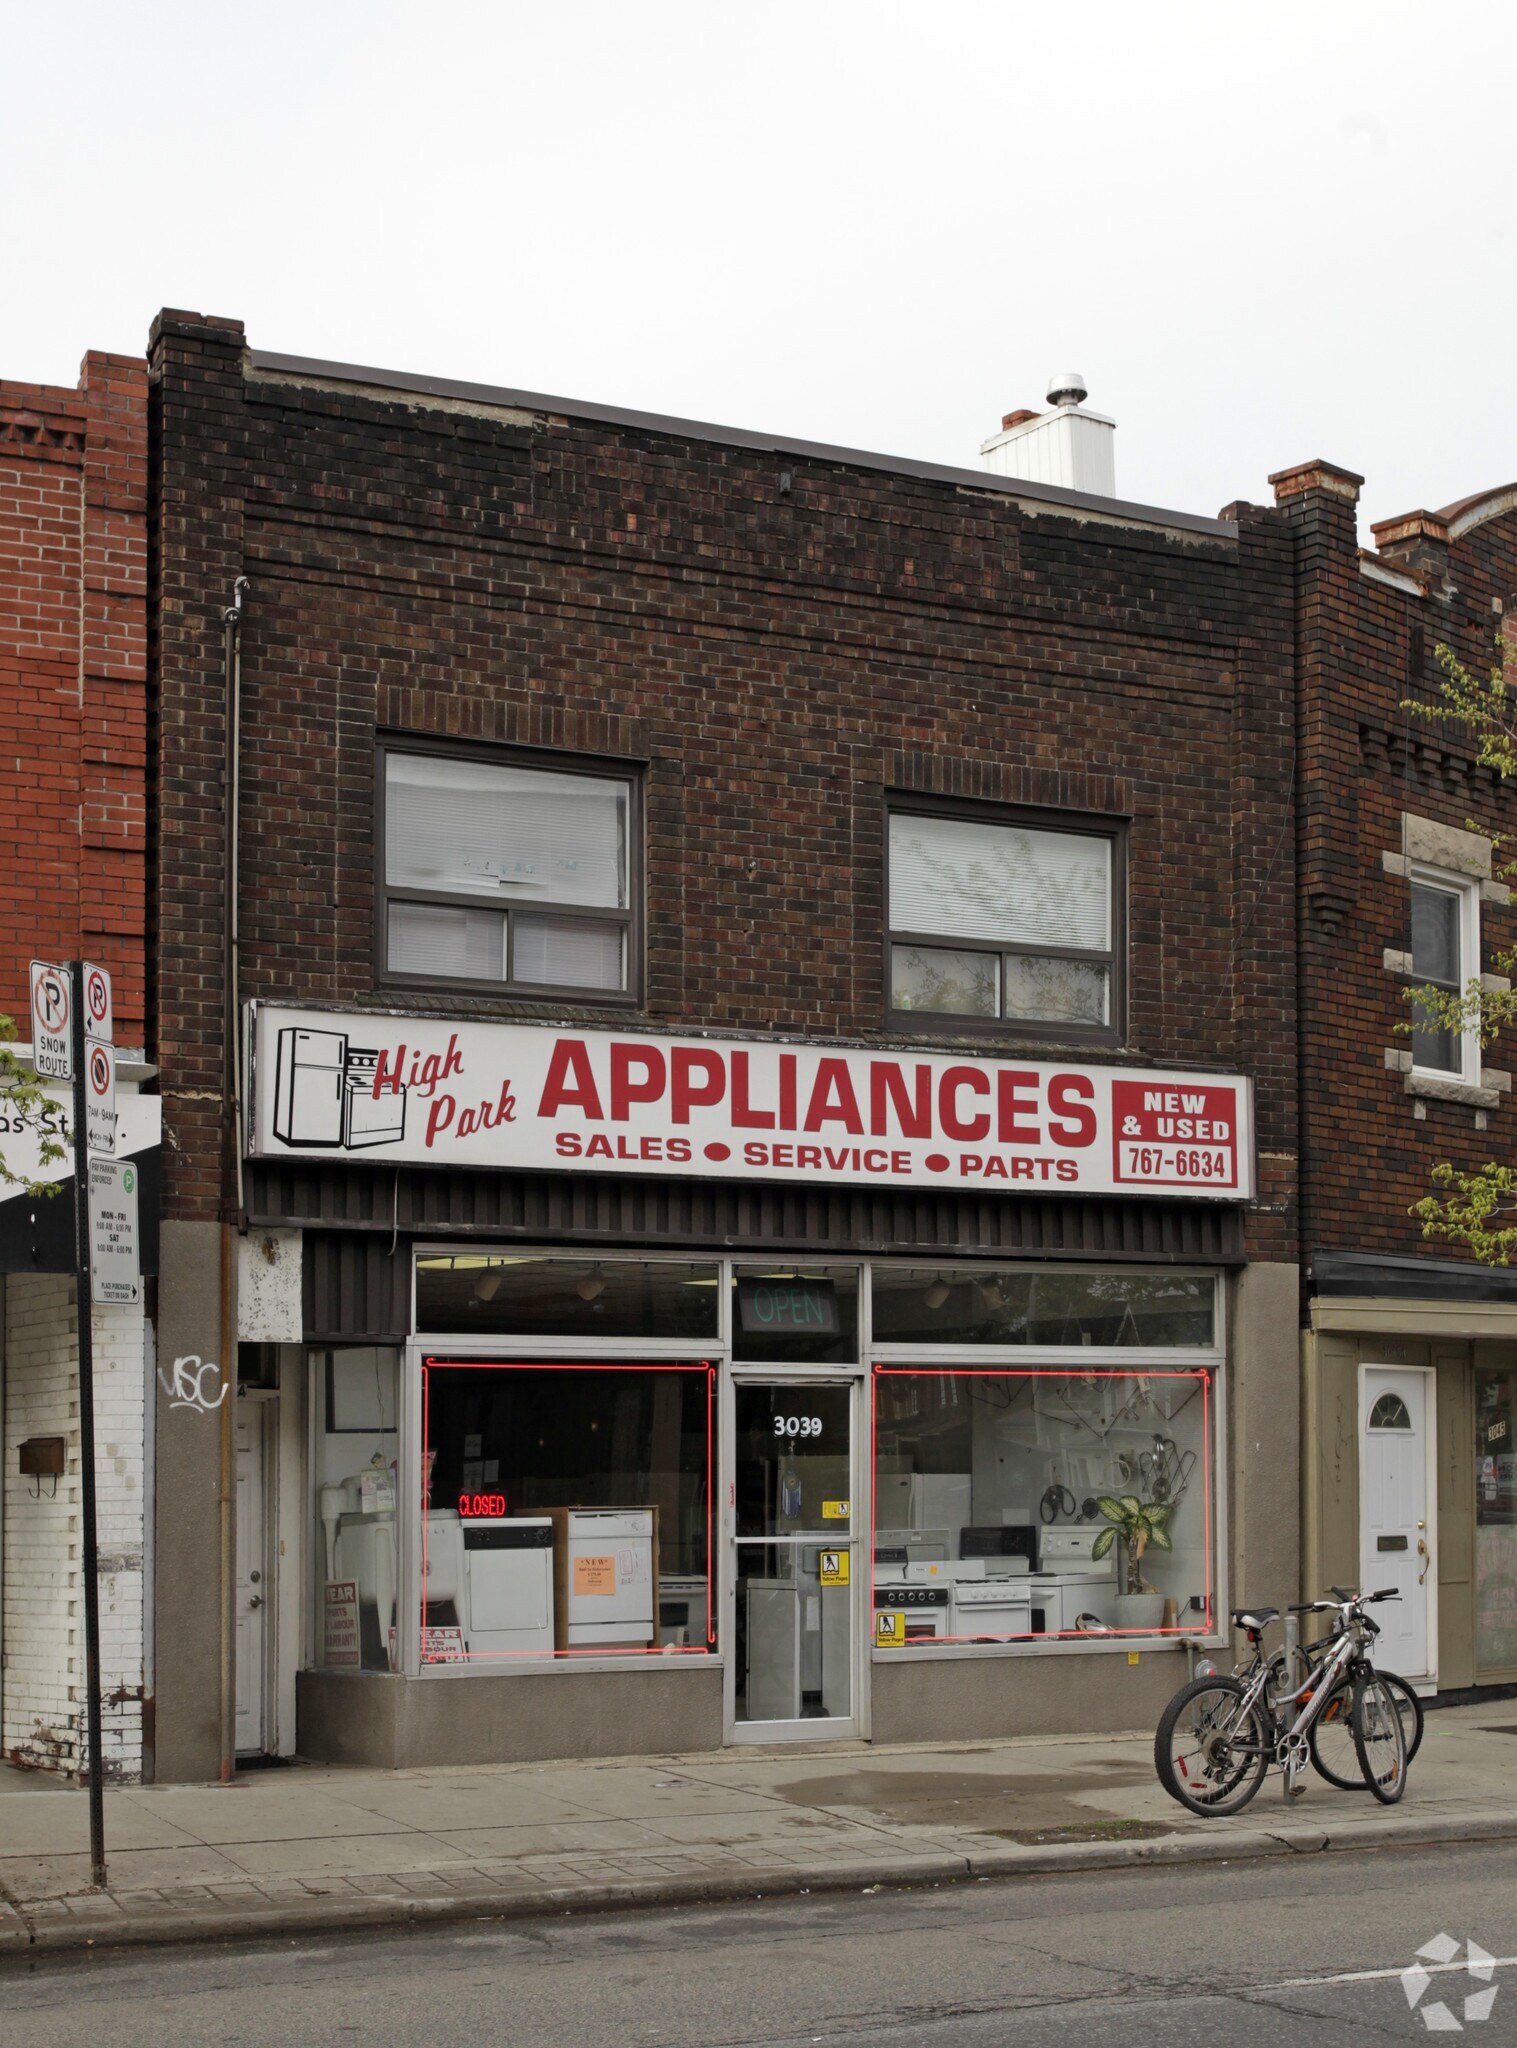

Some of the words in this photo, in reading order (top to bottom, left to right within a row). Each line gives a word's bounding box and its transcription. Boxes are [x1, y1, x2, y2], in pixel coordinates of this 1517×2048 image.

[40, 1036, 66, 1055] SNOW
[39, 1056, 68, 1075] ROUTE
[372, 1033, 464, 1099] High
[537, 1039, 1097, 1148] APPLIANCES
[1143, 1091, 1207, 1115] NEW
[424, 1079, 517, 1148] Park
[1121, 1115, 1142, 1136] &
[1156, 1117, 1230, 1141] USED
[556, 1132, 693, 1163] SALES
[744, 1142, 913, 1175] SERVICE
[960, 1153, 1080, 1183] PARTS
[1128, 1147, 1226, 1178] 767-6634
[109, 1233, 120, 1243] SAT
[754, 1286, 824, 1324] OPEN
[773, 1415, 823, 1437] 3039
[1488, 1421, 1506, 1441] 3045
[459, 1495, 506, 1516] CLOSED
